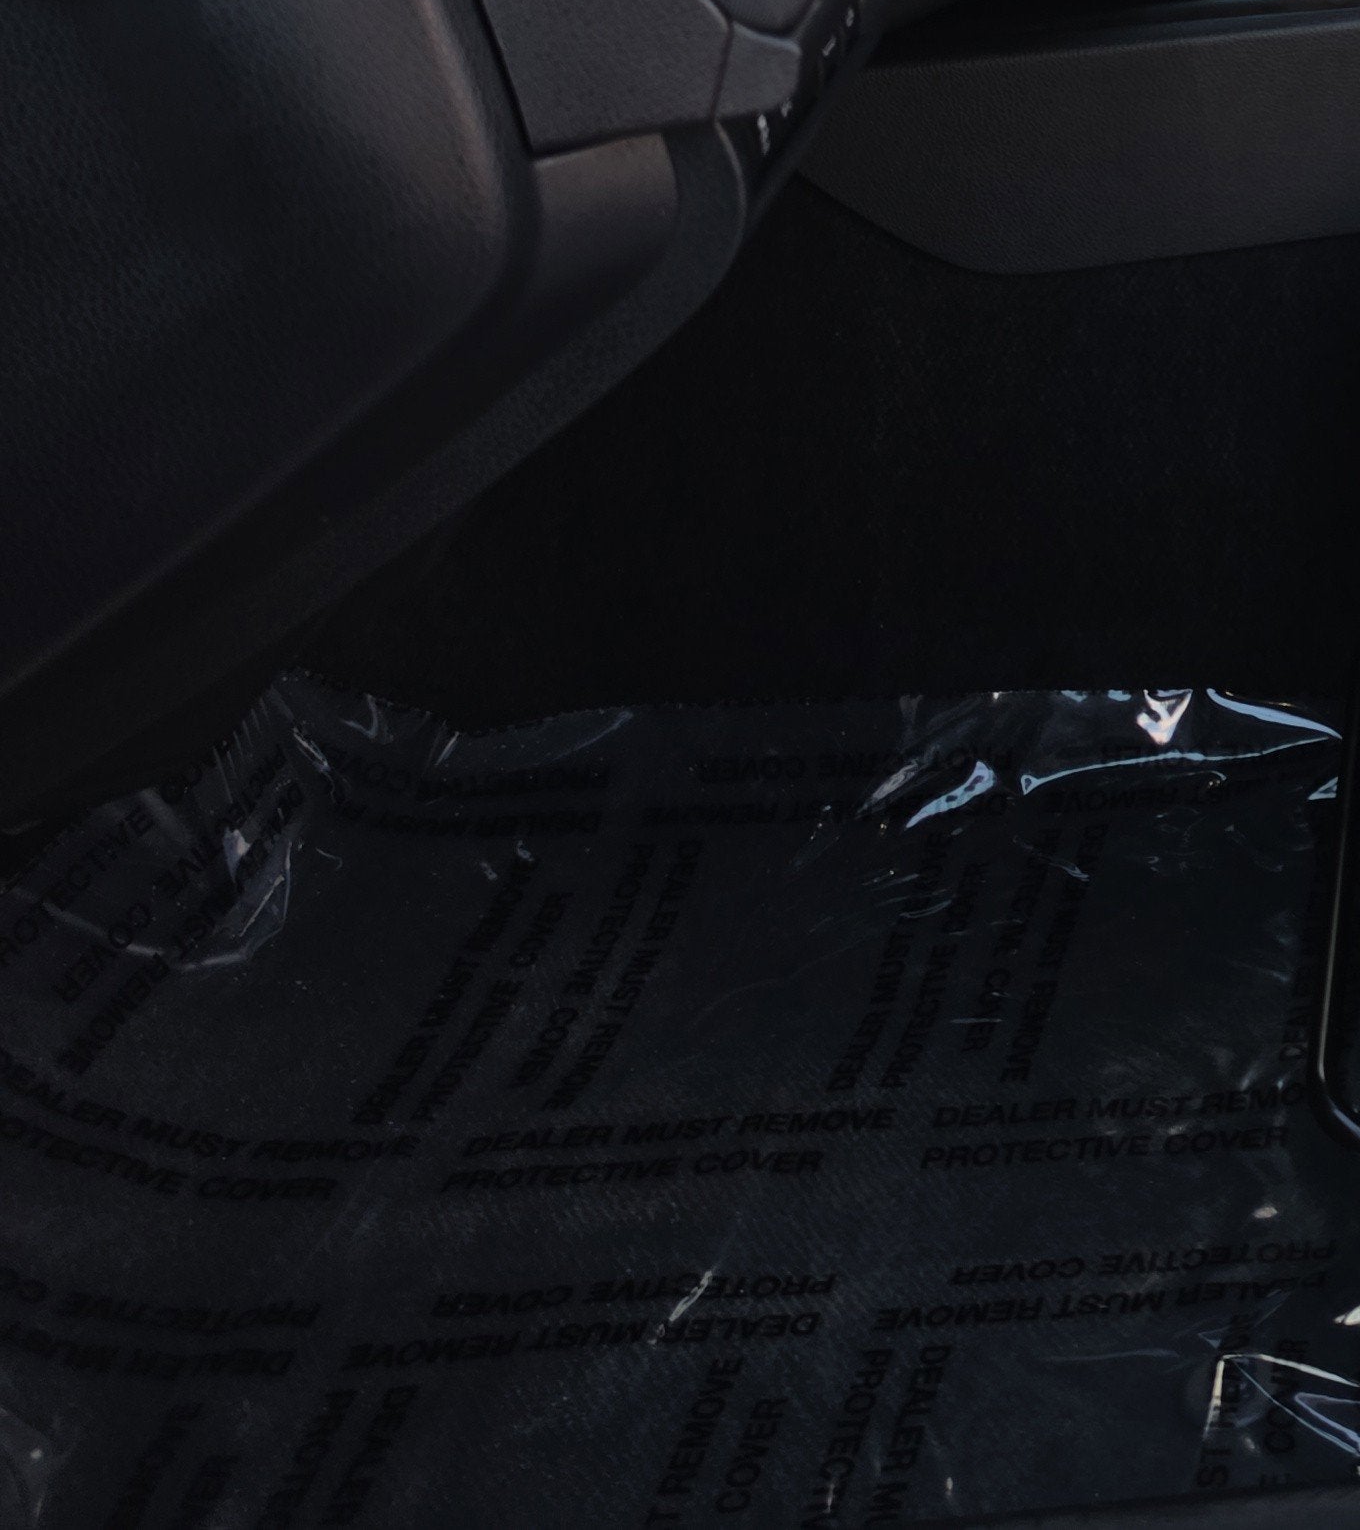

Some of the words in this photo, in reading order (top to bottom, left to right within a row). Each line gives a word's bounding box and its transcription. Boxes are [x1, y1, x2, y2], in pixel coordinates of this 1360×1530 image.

[324, 747, 412, 793] COVE
[699, 754, 806, 784] COVER
[641, 802, 778, 827] REMOVE
[0, 806, 155, 969] ROTECTIVE
[643, 838, 703, 942] DEALER
[563, 842, 656, 996] PROTECTIVE
[52, 903, 152, 1005] COVER
[605, 947, 663, 1016] MUST
[57, 954, 171, 1076] REMOVE
[508, 1006, 580, 1089] COVER
[932, 1098, 1078, 1130] DEALER
[1087, 1094, 1195, 1120] MUST
[1197, 1081, 1308, 1116] REMO
[131, 1117, 248, 1159] MUST
[250, 1134, 421, 1163] REMOVE
[462, 1125, 614, 1158] DEALER
[621, 1115, 735, 1146] MUST
[735, 1107, 898, 1136] REMOVE
[920, 1134, 1153, 1170] PROTECTIVE
[1163, 1126, 1290, 1157] COVER
[0, 1115, 190, 1195] OTECTIVE
[197, 1176, 339, 1201] COVER
[440, 1156, 684, 1194] PROTECTIVE
[692, 1150, 826, 1175] COVER
[948, 1257, 1087, 1286] COVER
[1101, 1240, 1338, 1274] PROTECTIVE
[431, 1285, 574, 1317] COVER
[582, 1274, 836, 1304] PROTECTIVE
[1053, 1290, 1166, 1320] MUST
[57, 1292, 322, 1337] PROTECTIVE
[527, 1319, 649, 1351] MUST
[660, 1313, 821, 1344] DEALER
[873, 1296, 1044, 1331] REMOVE
[341, 1331, 520, 1370] REMOVE
[658, 1357, 745, 1496] REMOVE
[888, 1345, 953, 1472] DEALER
[716, 1396, 788, 1514] COVER
